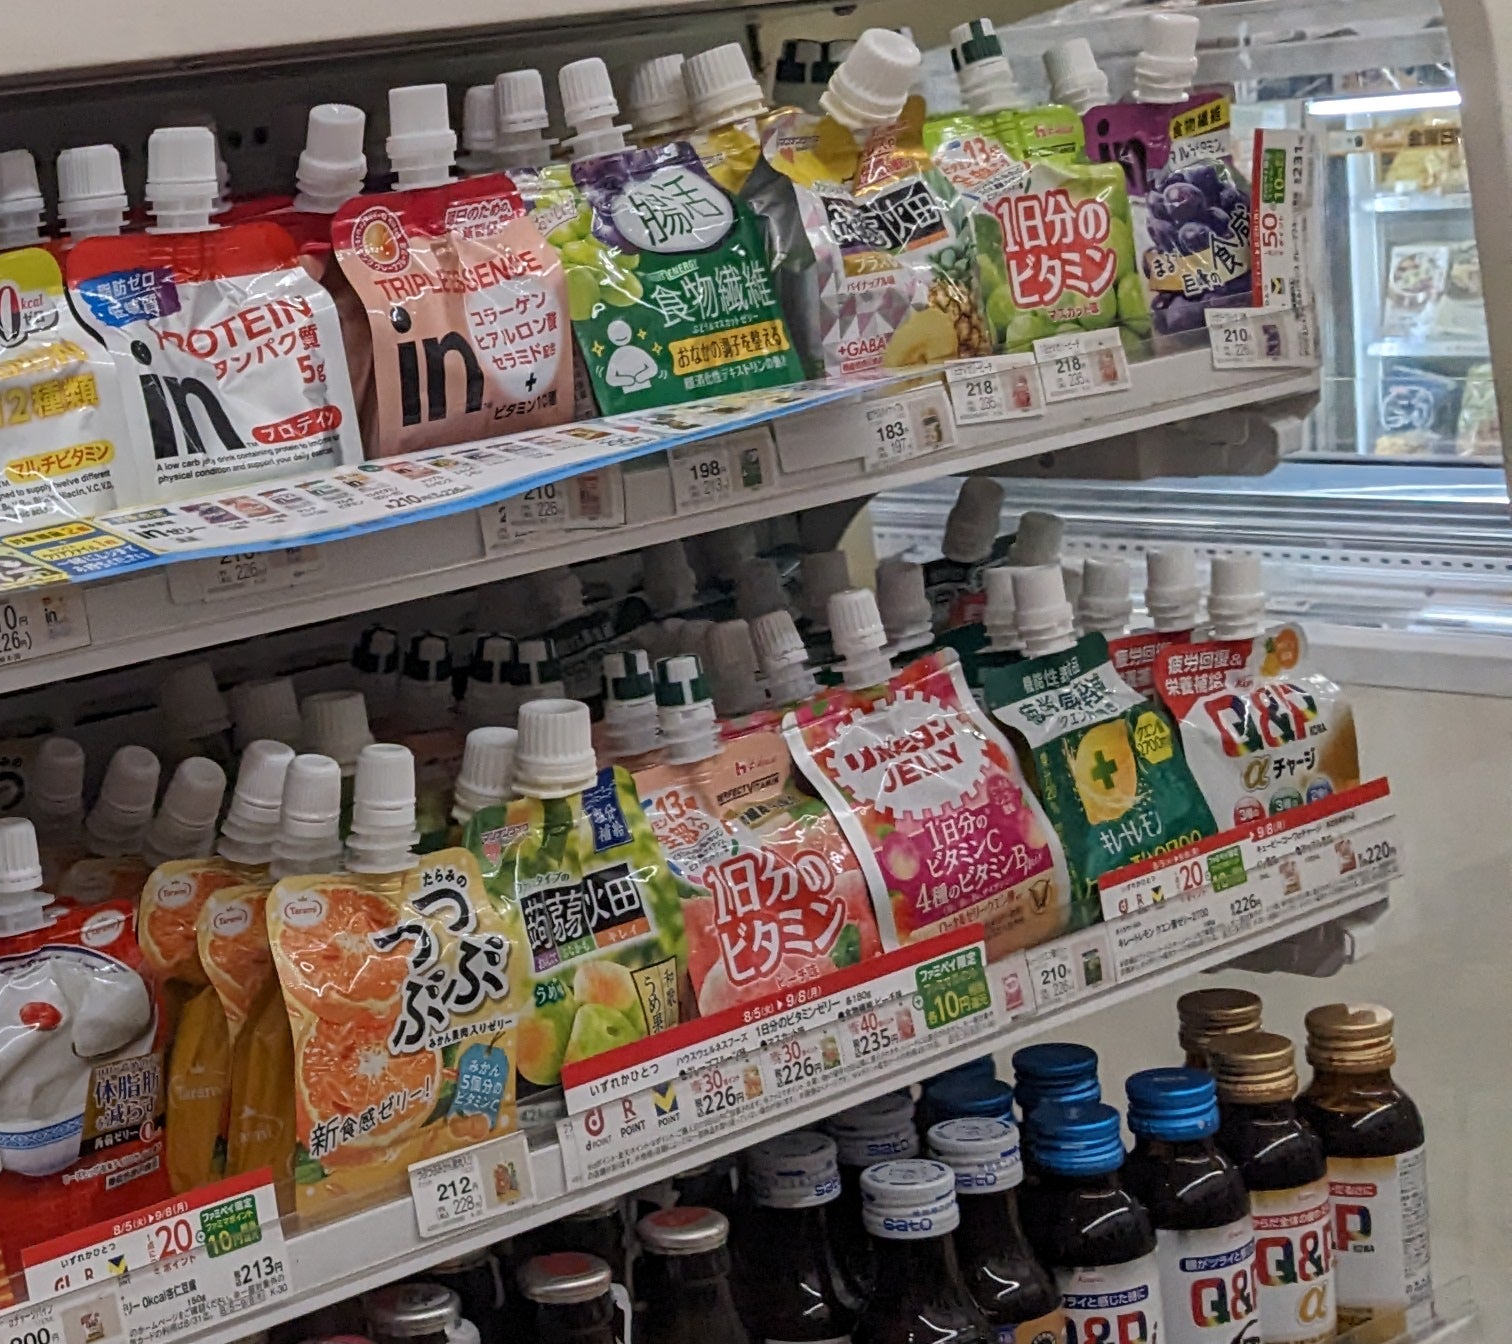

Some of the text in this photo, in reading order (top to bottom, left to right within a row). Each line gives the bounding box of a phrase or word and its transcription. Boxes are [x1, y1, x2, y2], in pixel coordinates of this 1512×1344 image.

[1006, 246, 1117, 306] ビタミン
[422, 870, 468, 889] たらみの
[720, 898, 844, 983] ビタミン
[882, 1214, 934, 1234] sato
